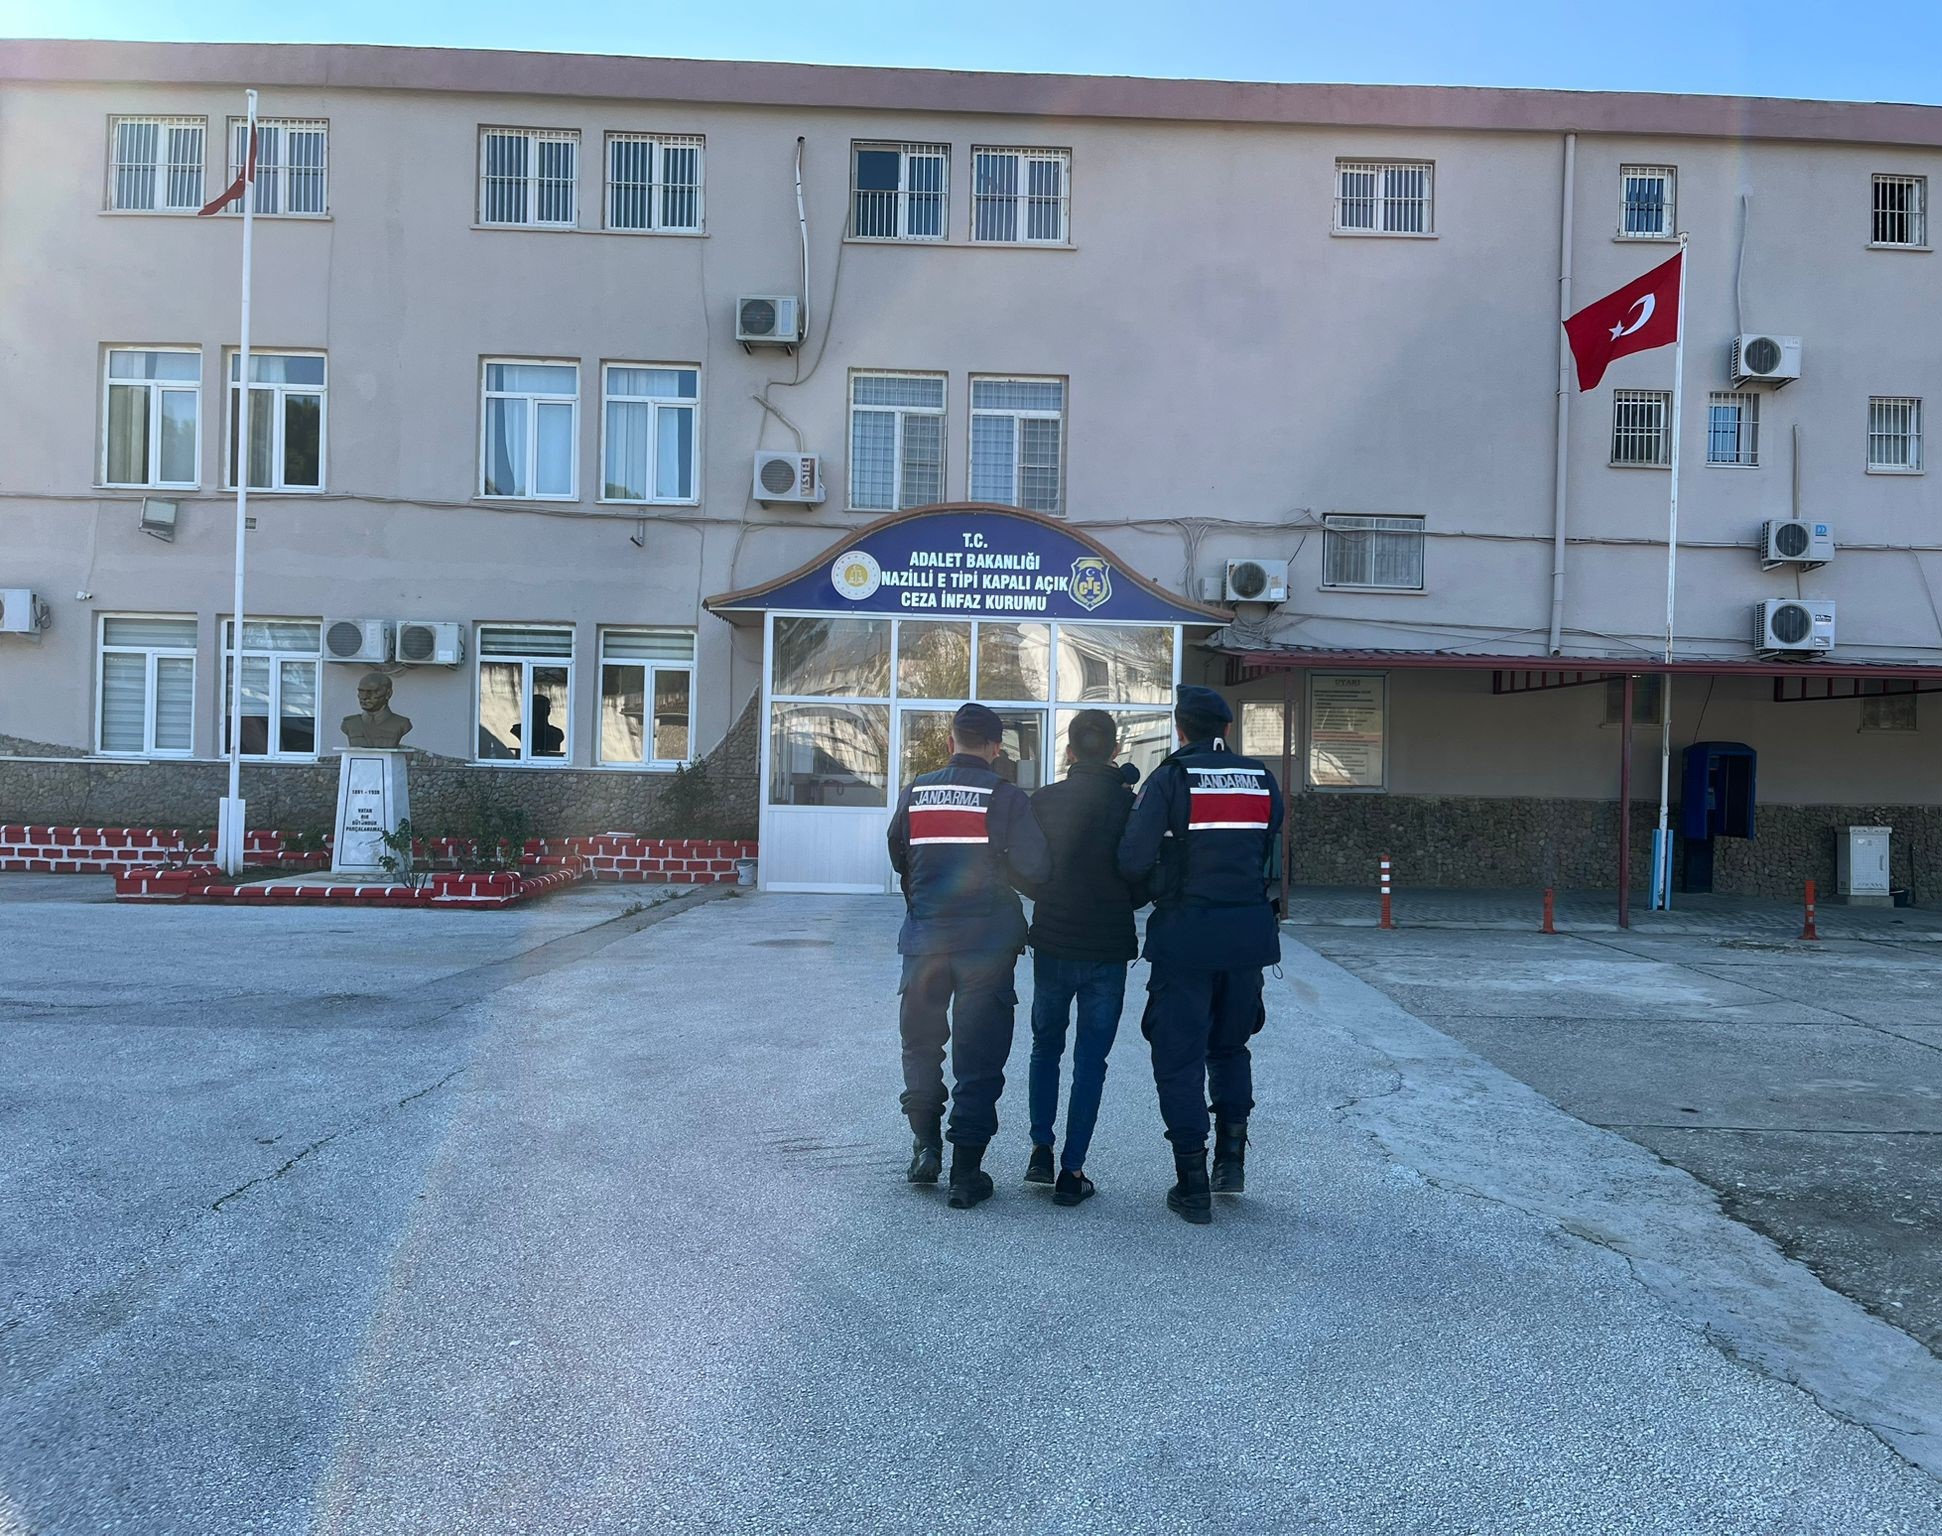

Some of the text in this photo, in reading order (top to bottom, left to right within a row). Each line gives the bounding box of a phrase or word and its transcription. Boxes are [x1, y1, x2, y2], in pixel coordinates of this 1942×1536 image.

[801, 457, 811, 494] VESTEL
[963, 533, 988, 548] T.C.
[909, 552, 1040, 570] ADALET BAKANLIĞI
[882, 570, 1069, 593] NAZİLLİ E TİPİ KAPALI AÇIK
[901, 590, 1047, 611] CEZA İNFAZ KURUMU
[1198, 774, 1260, 789] JANDARMA
[915, 790, 979, 806] JANDARMA
